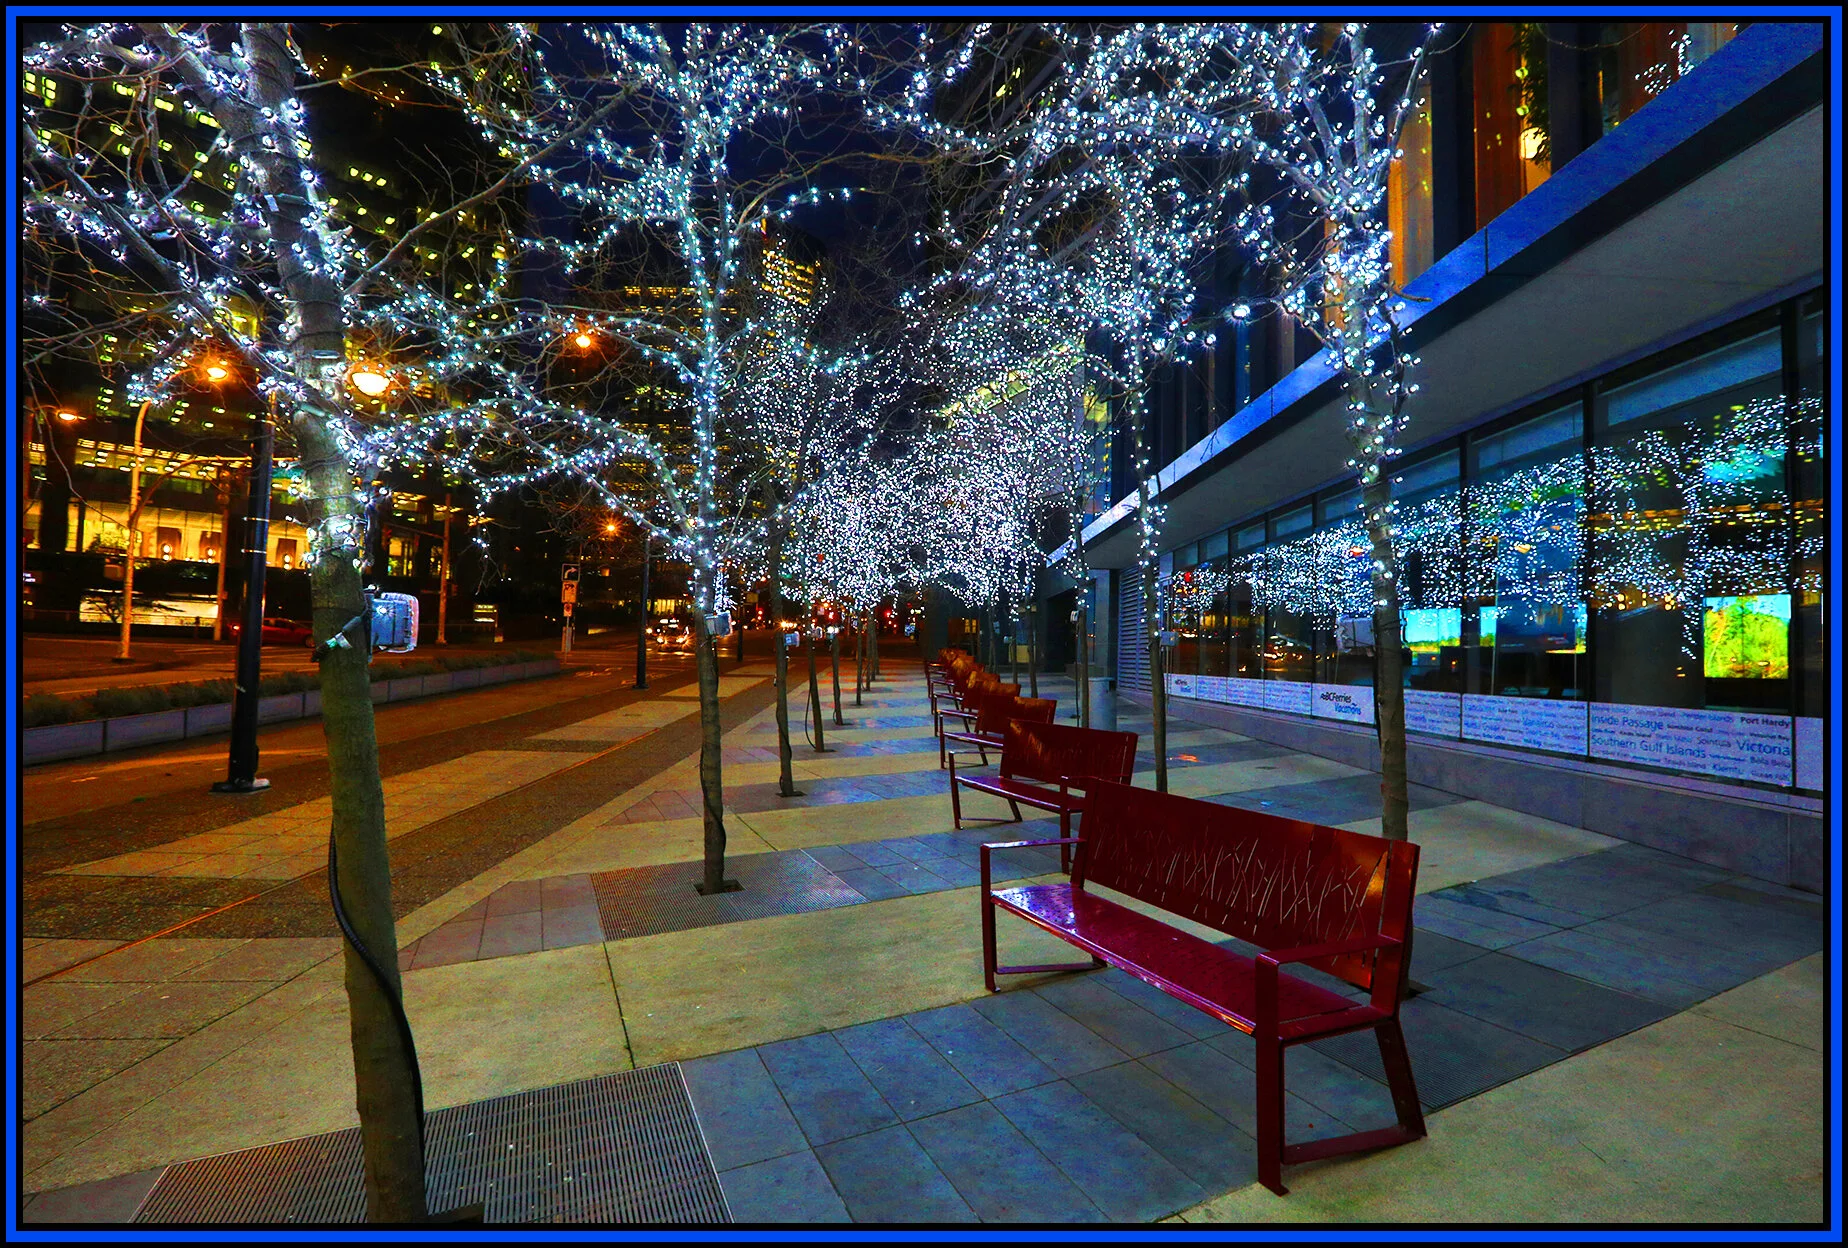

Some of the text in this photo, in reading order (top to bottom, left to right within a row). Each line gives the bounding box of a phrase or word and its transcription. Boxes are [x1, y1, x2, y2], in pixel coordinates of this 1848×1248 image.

[1591, 715, 1619, 725] Inside
[1622, 716, 1664, 732] Passage
[1740, 716, 1790, 728] Port Hardy
[1591, 734, 1636, 750] Southern
[1640, 740, 1662, 752] Gulf
[1666, 744, 1706, 758] Islands
[1736, 739, 1790, 756] Victoria
